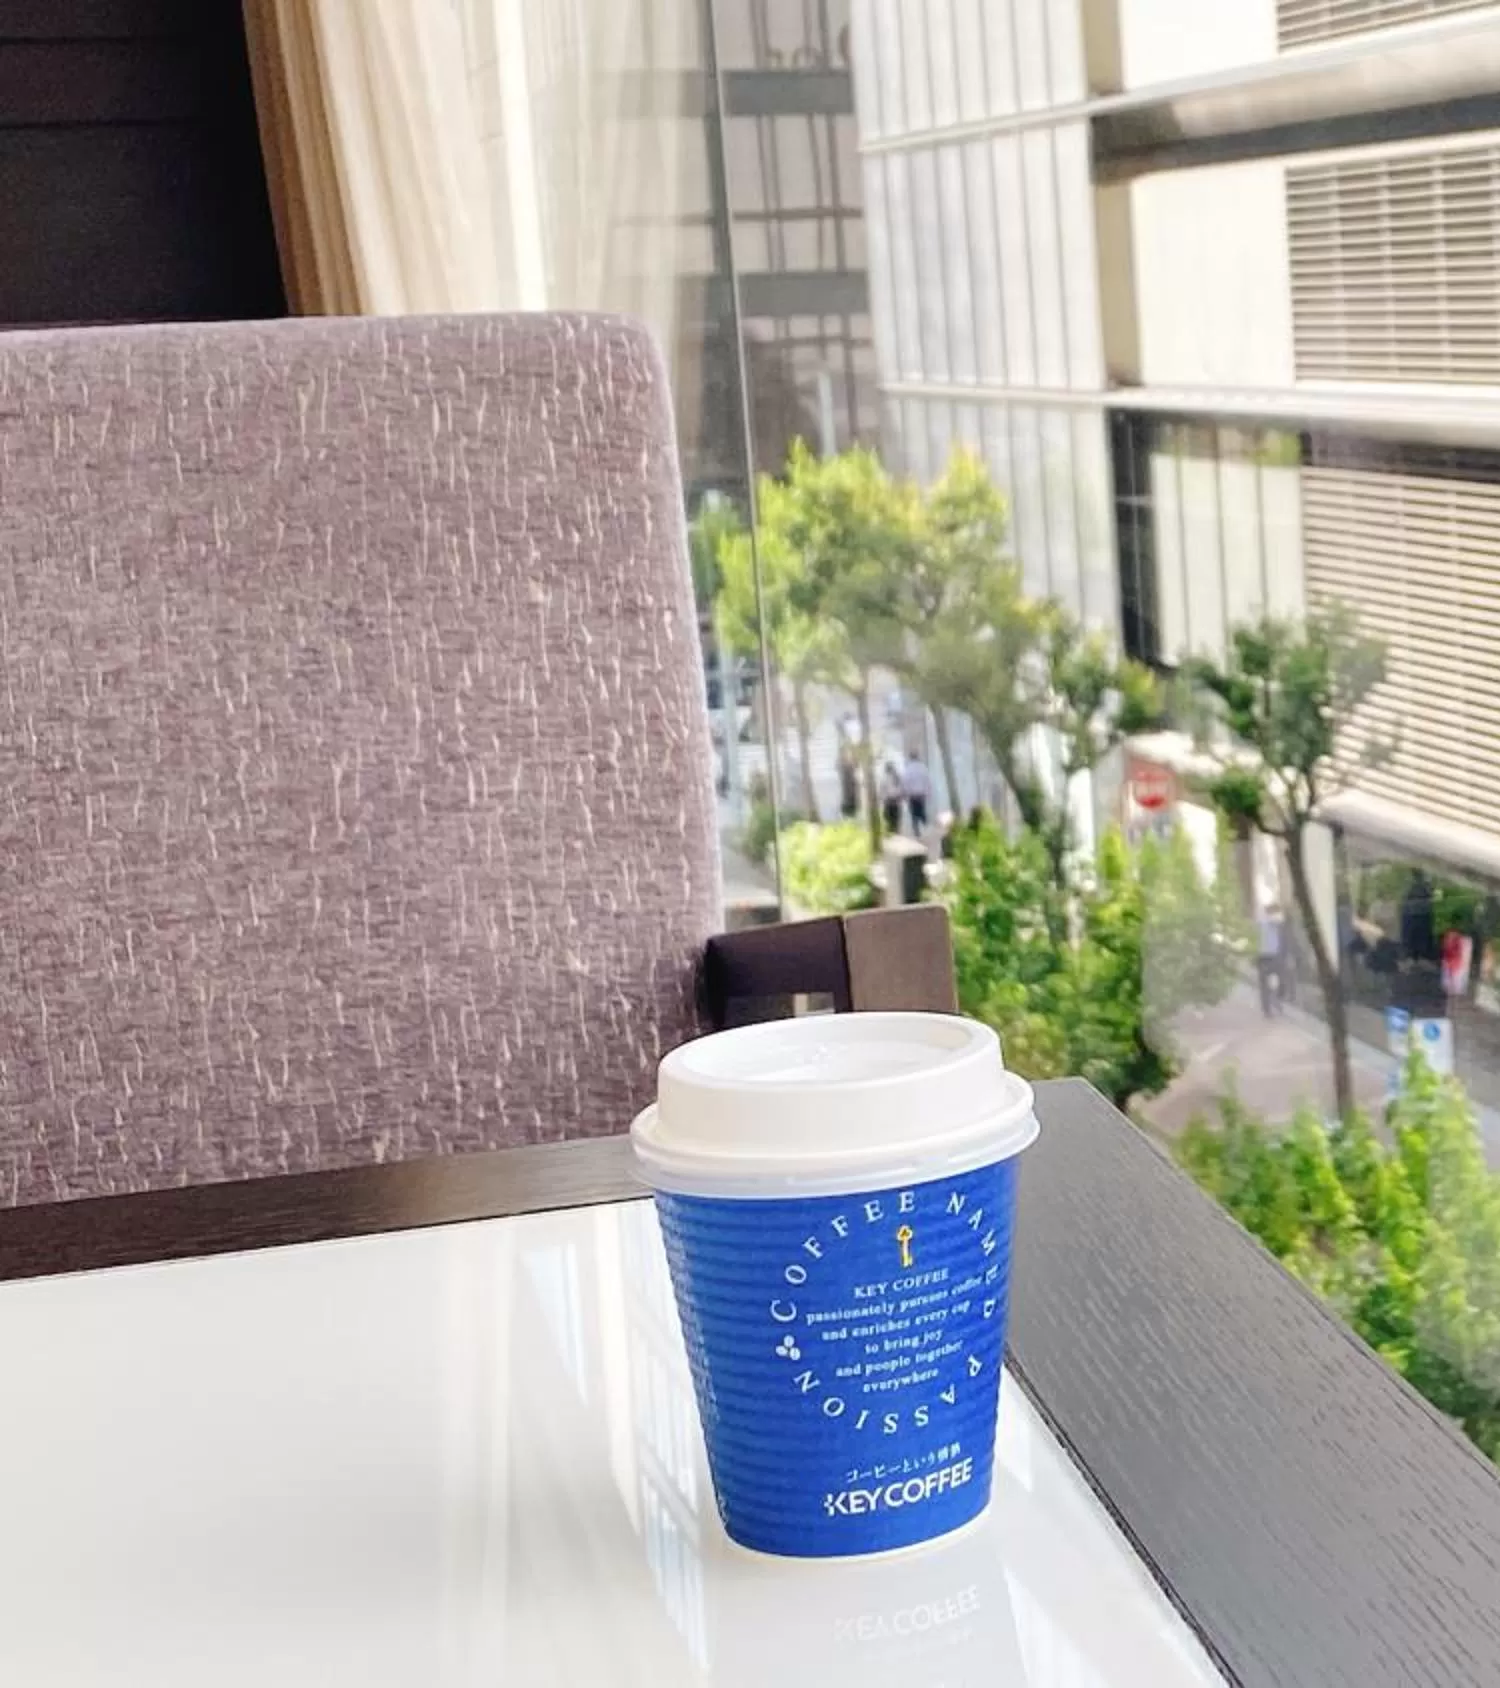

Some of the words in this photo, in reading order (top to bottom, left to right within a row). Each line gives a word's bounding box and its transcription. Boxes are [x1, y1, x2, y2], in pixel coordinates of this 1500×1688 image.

[770, 1191, 916, 1322] COFFEE
[853, 1281, 889, 1300] KEY
[892, 1267, 949, 1292] COFFEE
[805, 1301, 894, 1327] passionately
[821, 1327, 848, 1341] and
[851, 1318, 910, 1338] enriches
[914, 1308, 949, 1326] every
[864, 1343, 880, 1355] to
[883, 1335, 920, 1352] bring
[835, 1363, 862, 1378] and
[865, 1357, 911, 1376] people
[862, 1368, 939, 1393] everywhere
[794, 1356, 983, 1434] PASSION
